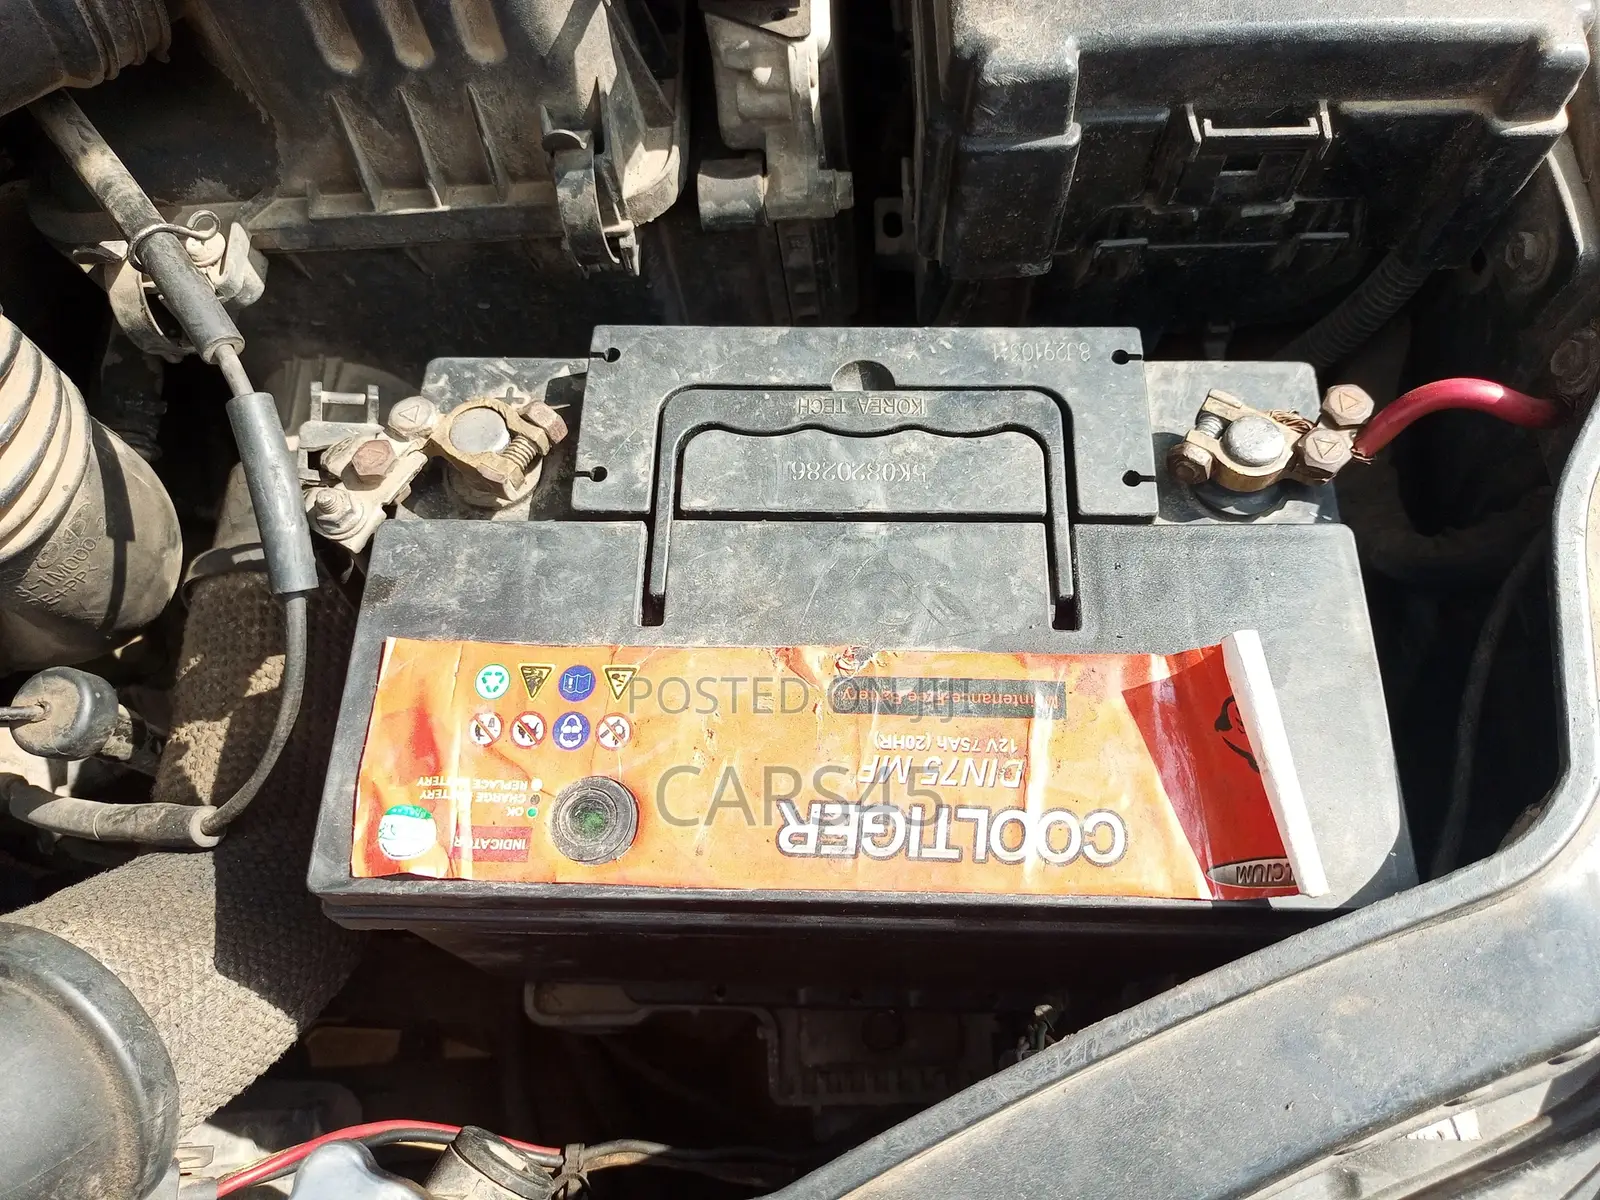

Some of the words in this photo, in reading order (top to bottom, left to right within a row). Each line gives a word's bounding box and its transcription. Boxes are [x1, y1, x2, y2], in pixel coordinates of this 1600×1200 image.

[798, 398, 846, 415] TECH
[857, 398, 927, 416] KOREA
[907, 688, 1059, 708] Mintenance-Free
[873, 732, 932, 752] (20HR)
[937, 735, 983, 753] 75Ah
[986, 738, 1018, 754] 12V
[859, 753, 913, 786] MF
[920, 755, 1026, 789] DIN75
[416, 775, 471, 790] TTERY
[472, 778, 528, 791] REPLACE
[419, 788, 471, 802] TTERY
[477, 792, 527, 804] CHARGE
[507, 806, 525, 817] OK
[776, 799, 1129, 867] COOLTIGER
